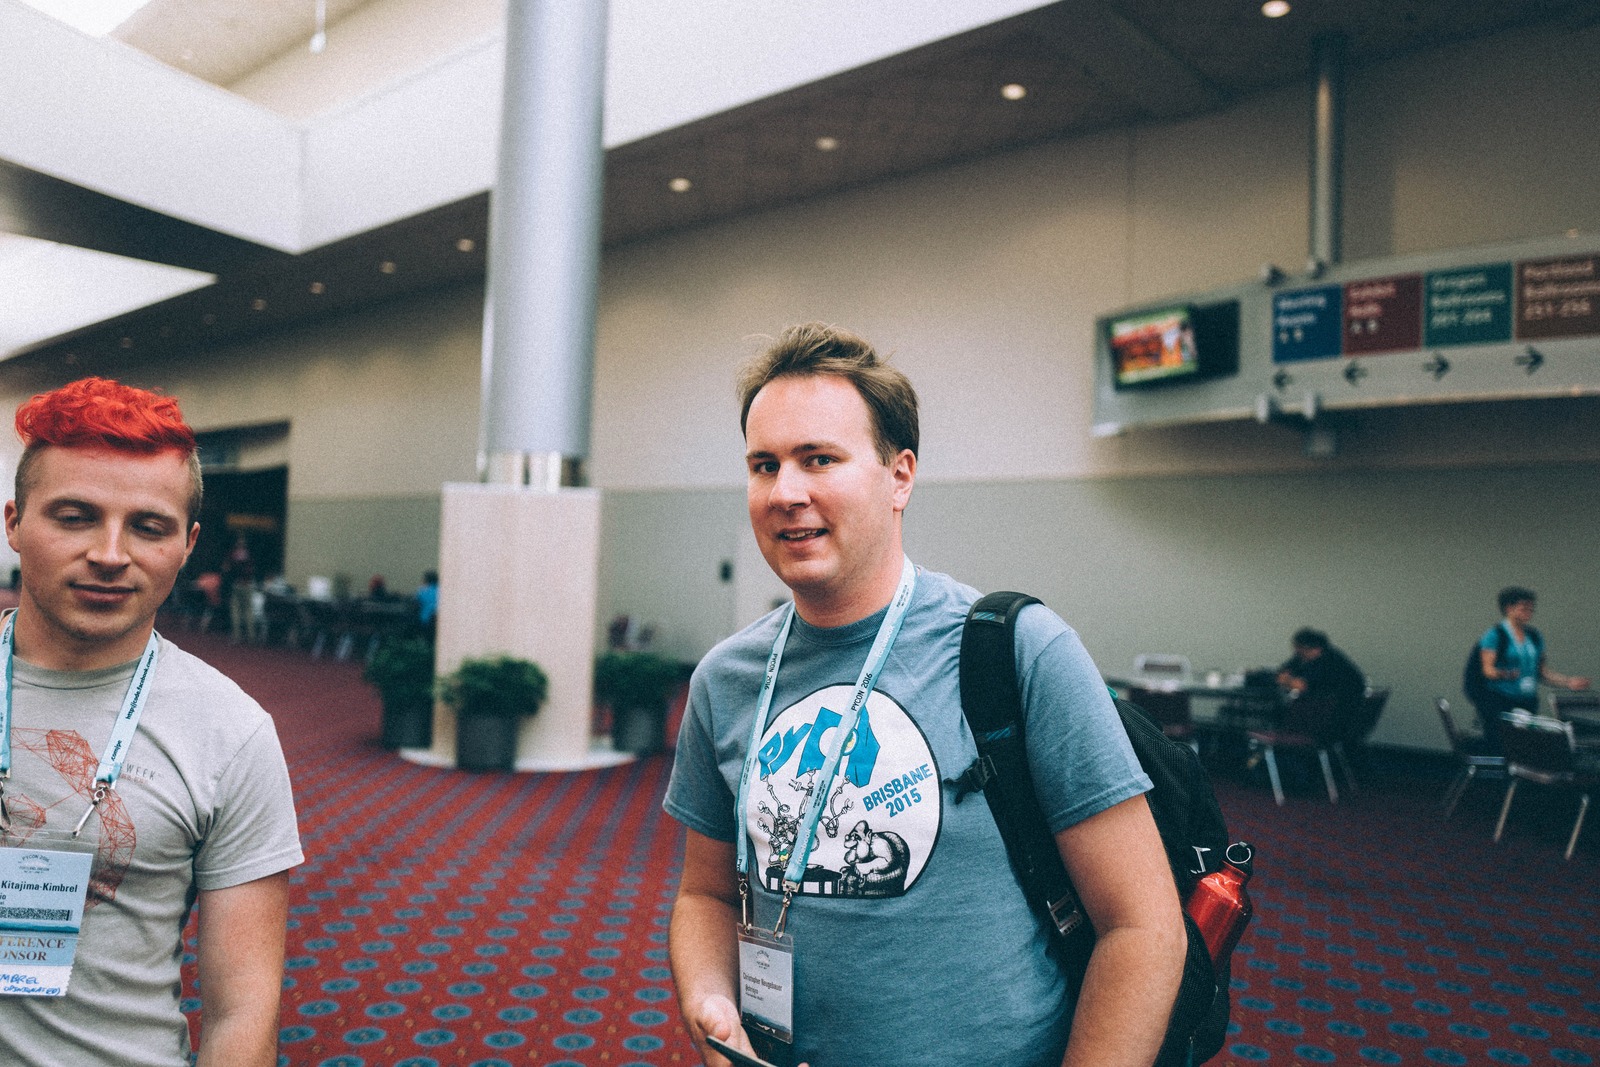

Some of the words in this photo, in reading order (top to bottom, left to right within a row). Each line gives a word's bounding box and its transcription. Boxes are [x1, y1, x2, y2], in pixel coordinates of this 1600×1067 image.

[769, 653, 778, 673] PYCON
[764, 675, 773, 690] 2016
[851, 690, 865, 711] PYCON
[861, 673, 873, 689] 2016
[126, 763, 156, 781] WEEK
[863, 763, 933, 812] BRISBANE
[885, 787, 923, 818] 2015
[1, 880, 78, 893] Kitajima-Kimbrel
